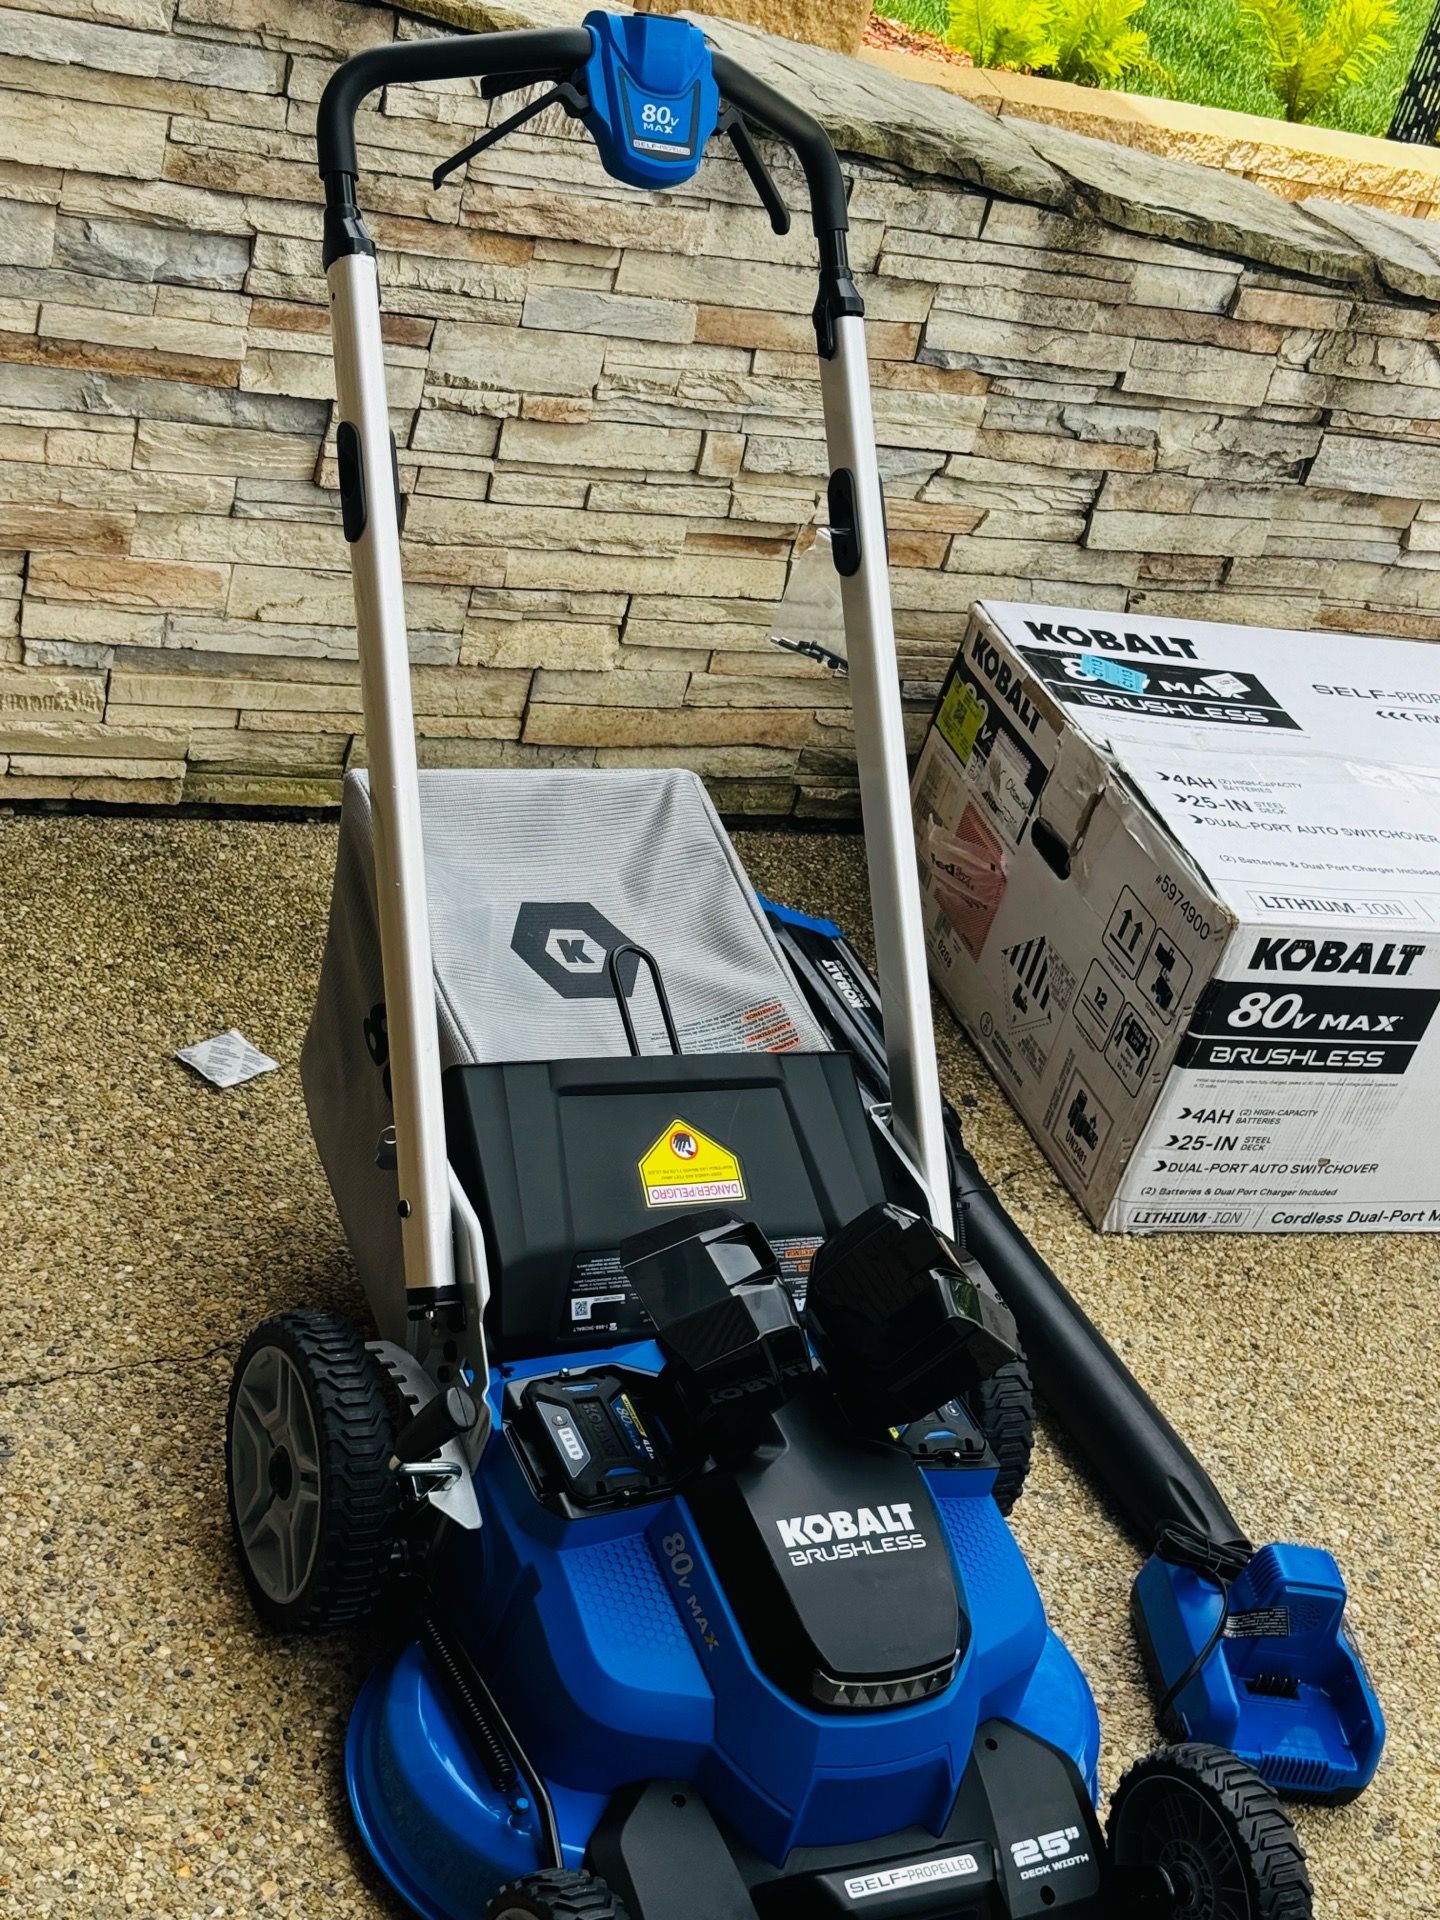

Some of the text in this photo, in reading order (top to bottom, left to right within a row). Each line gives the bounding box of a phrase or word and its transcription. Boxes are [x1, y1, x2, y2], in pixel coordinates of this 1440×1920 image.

[643, 123, 673, 134] MAX
[1023, 621, 1200, 660] KOBALT
[971, 630, 1043, 735] KOBALT
[1080, 691, 1269, 723] BRUSHLESS
[1173, 774, 1218, 789] 4AH
[1187, 795, 1253, 812] 25-IN
[1204, 817, 1440, 843] DUAL-PORT AUTO SWITCHOVER
[1219, 854, 1237, 864] (2)
[1238, 856, 1288, 868] Batteries
[1300, 861, 1325, 870] Dual
[1328, 863, 1350, 872] Port
[1352, 865, 1394, 876] Charger
[1155, 874, 1210, 941] #5974900
[1259, 895, 1404, 916] LITHIUM-ION
[1248, 937, 1427, 976] KOBALT
[821, 959, 865, 1009] KOBALT
[1209, 1046, 1386, 1068] BRUSHLESS
[1191, 1109, 1235, 1124] 4AH
[1252, 1109, 1319, 1118] HIGH-CAPACITY
[1178, 1136, 1239, 1151] 25-IN
[1240, 1143, 1266, 1151] DECK
[1244, 1136, 1272, 1144] STEEL
[1167, 1163, 1379, 1175] DUAL-PORT AUTO SWITCHOVER
[1140, 1187, 1338, 1198] (2) Batteries & Dual Port Charger Included
[1133, 1211, 1243, 1224] LITHIUM-ION
[1271, 1211, 1343, 1224] Cordless
[1346, 1209, 1425, 1223] Dual-Port
[776, 1503, 915, 1548] KOBALT
[788, 1534, 927, 1566] BRUSHLESS
[686, 1595, 720, 1652] MAX
[849, 1857, 975, 1894] SELF-PROPELLED
[1020, 1854, 1090, 1880] DECK WIDTH
